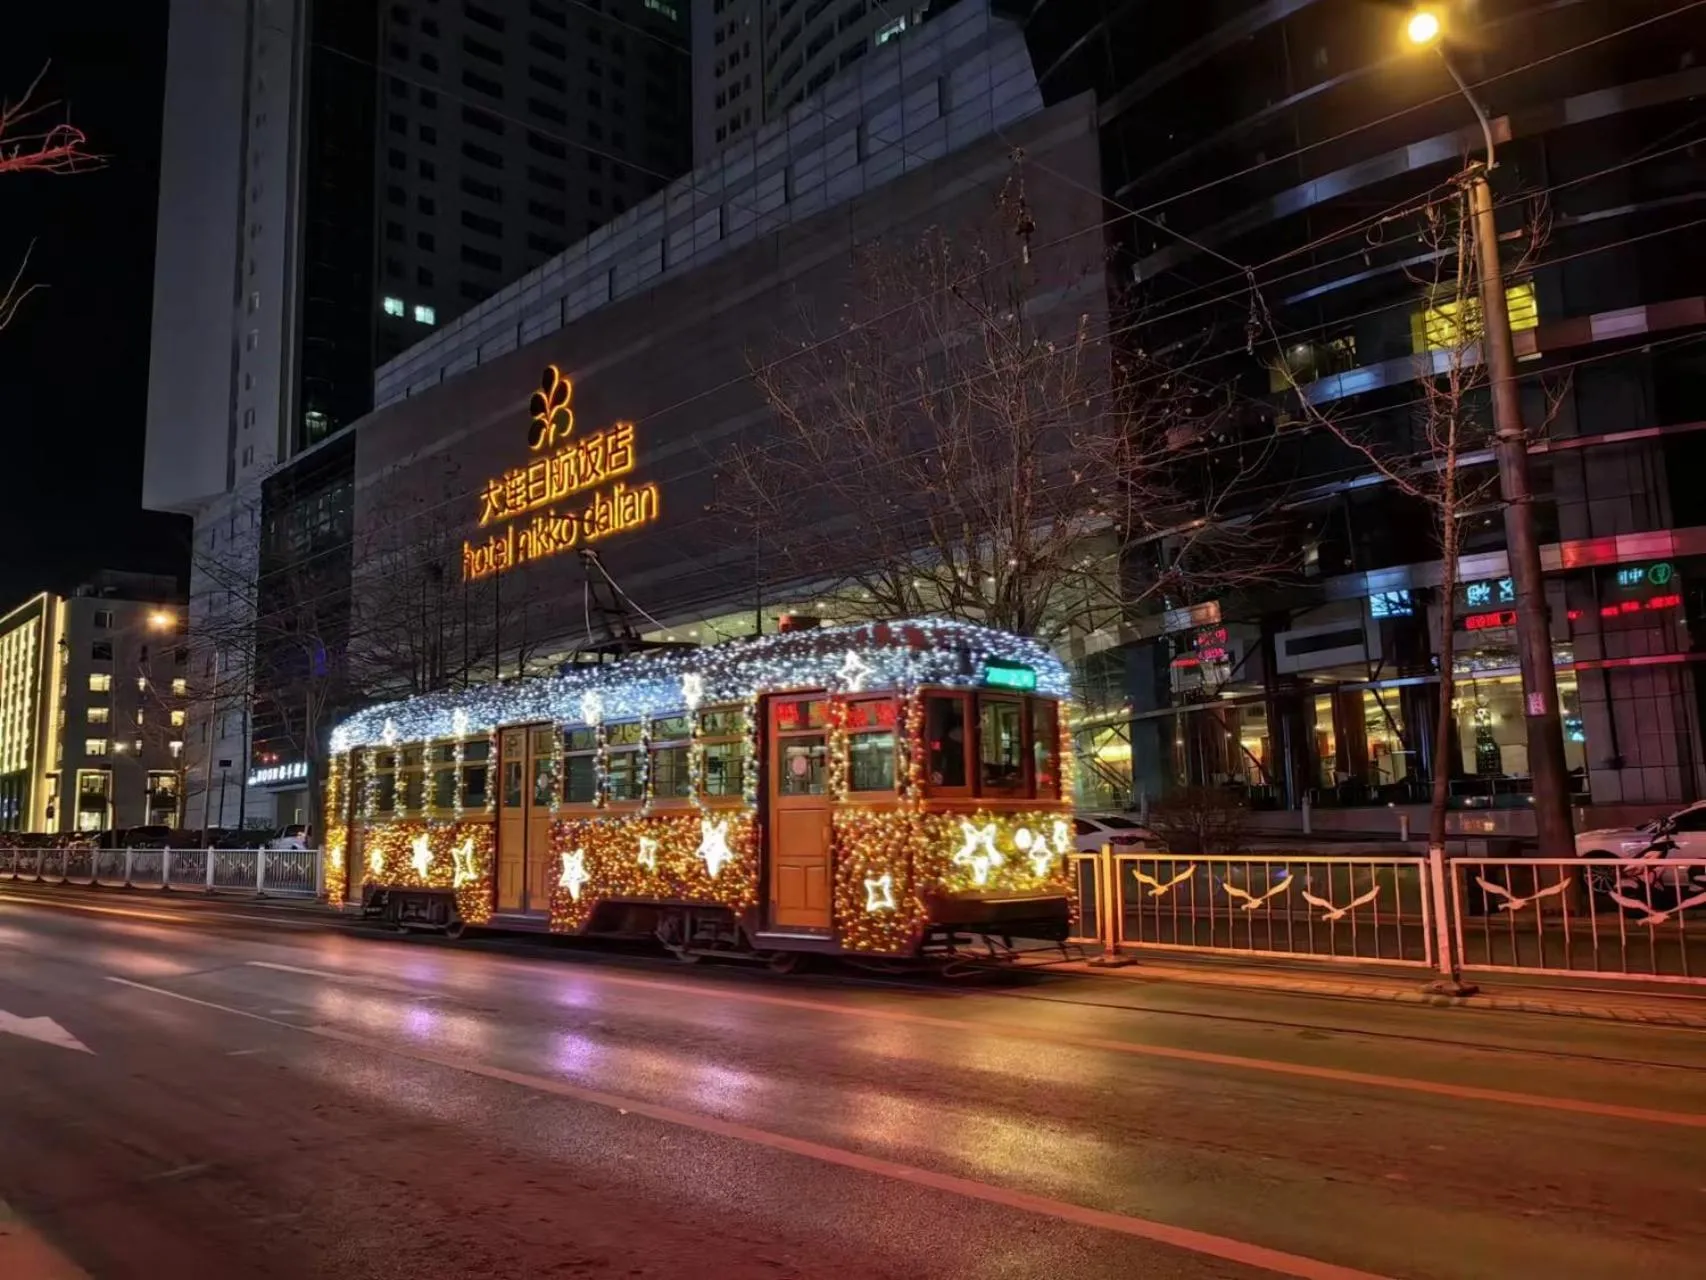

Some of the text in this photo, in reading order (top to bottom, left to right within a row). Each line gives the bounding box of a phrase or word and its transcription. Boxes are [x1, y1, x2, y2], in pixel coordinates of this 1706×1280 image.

[463, 482, 658, 582] hotel nikko dalian
